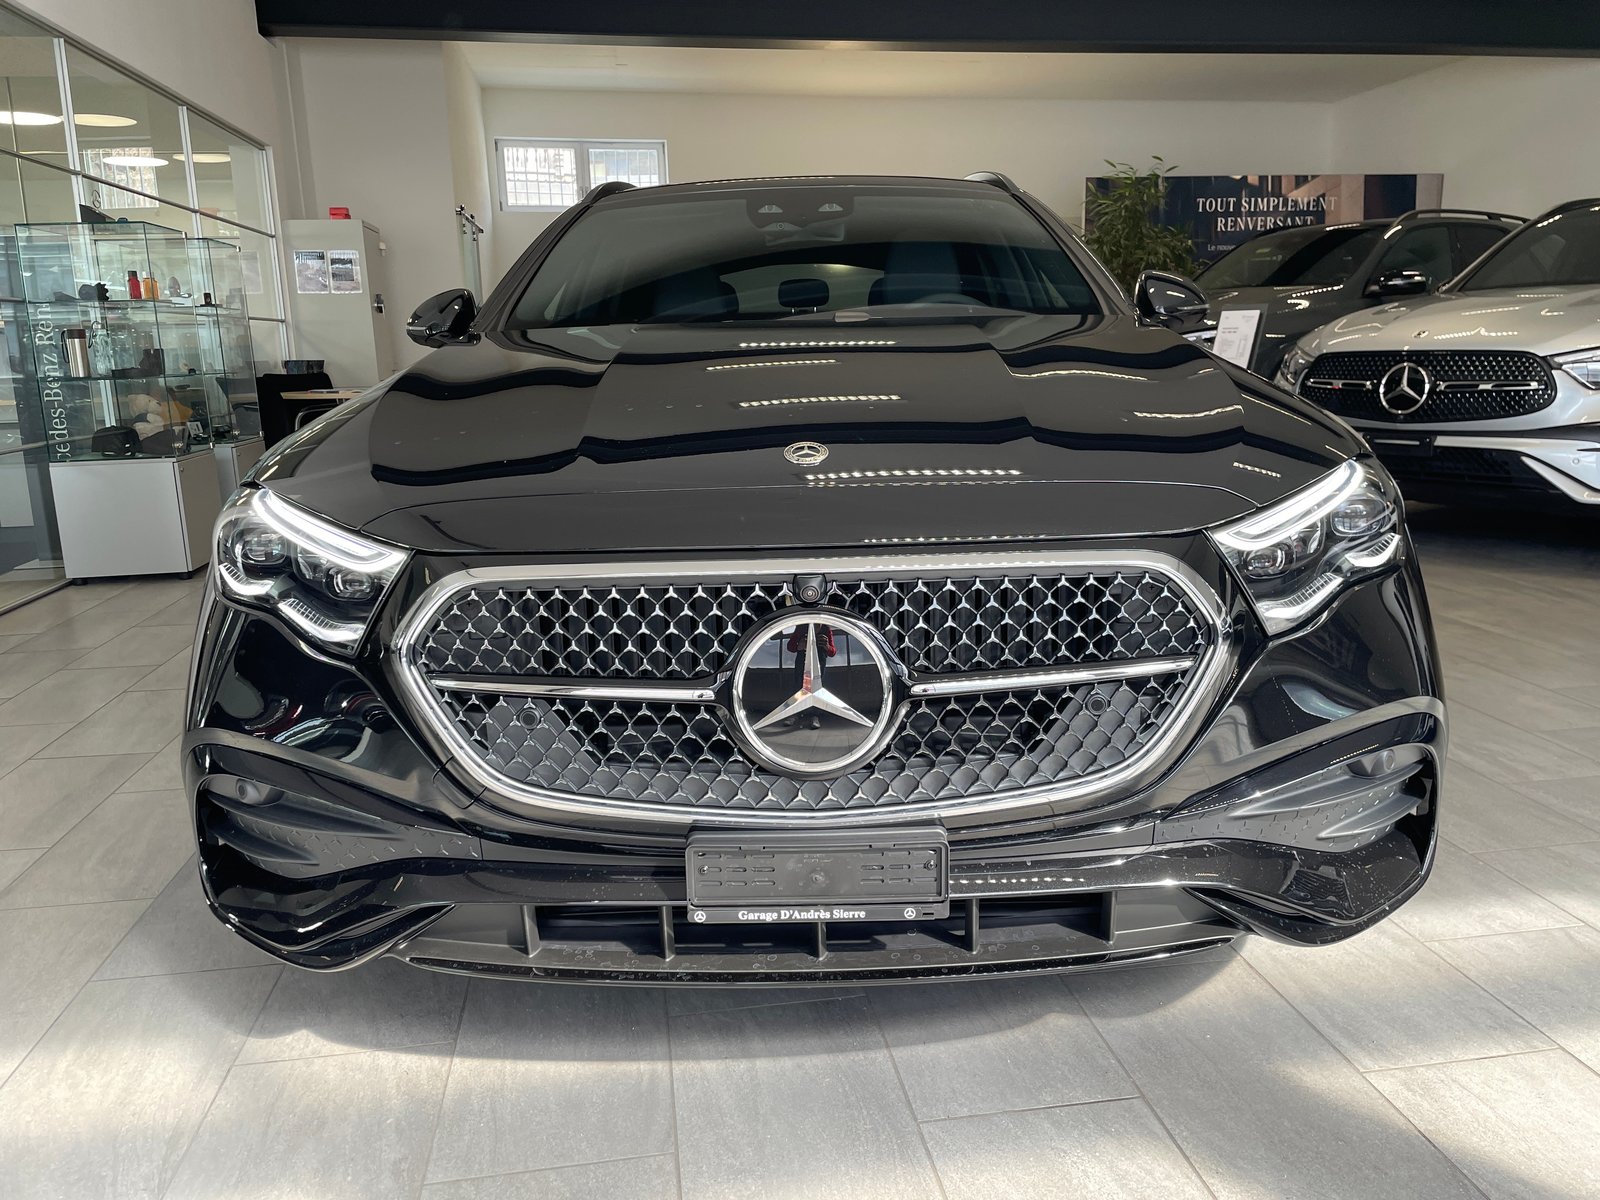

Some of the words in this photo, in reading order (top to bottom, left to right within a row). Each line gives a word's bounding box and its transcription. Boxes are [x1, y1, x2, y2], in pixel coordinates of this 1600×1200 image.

[1196, 197, 1237, 213] TOUT
[1240, 196, 1338, 212] SIMPLEMENT
[1216, 215, 1314, 232] RENVERSANT
[738, 910, 778, 922] Garage
[832, 908, 866, 919] Sierre
